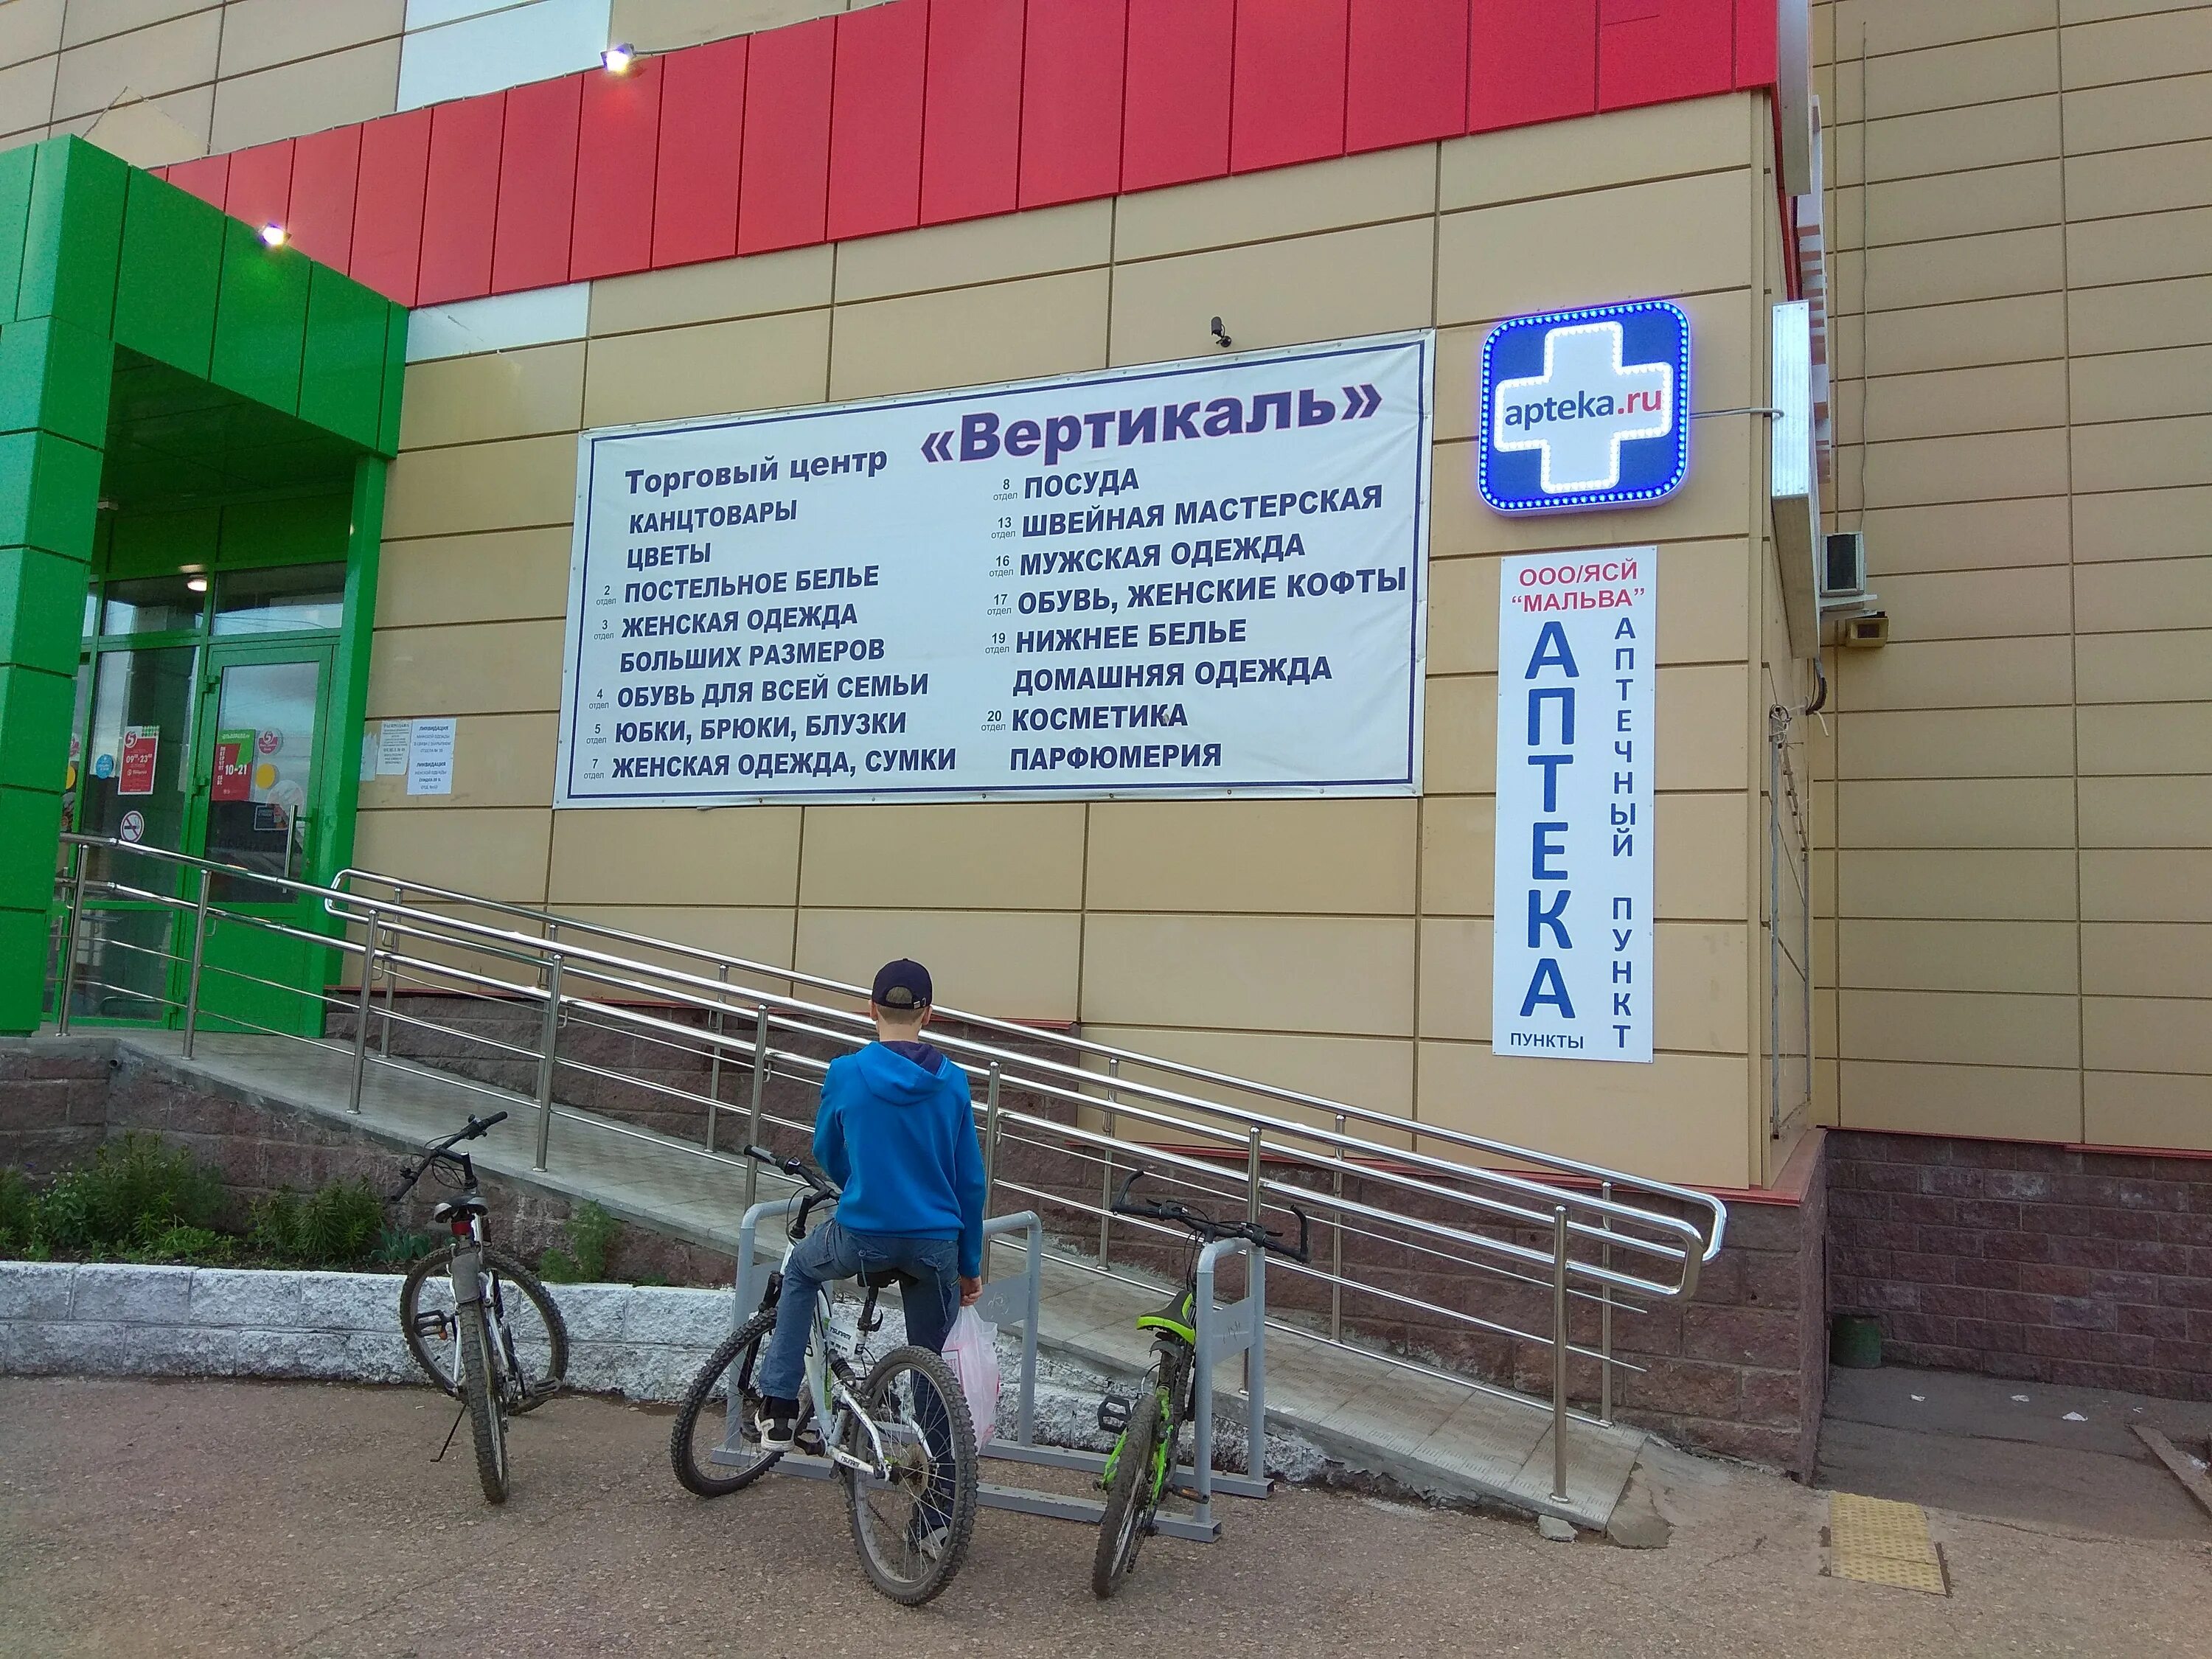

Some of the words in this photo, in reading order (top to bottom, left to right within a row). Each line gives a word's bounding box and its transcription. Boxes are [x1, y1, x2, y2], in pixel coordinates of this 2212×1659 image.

[1505, 390, 1661, 431] apteka.ru
[625, 455, 778, 496] Торговый
[790, 449, 887, 482] центр
[921, 381, 1382, 466] «Вертикаль»
[1003, 479, 1009, 490] 8
[1025, 468, 1139, 499] ПОСУДА
[993, 492, 1018, 501] отдел
[630, 500, 797, 534] КАНЦТОВАРЫ
[1023, 504, 1164, 538] ШВЕЙНАЯ
[1175, 484, 1382, 525] МАСТЕРСКАЯ
[998, 517, 1011, 528] 13
[991, 530, 1015, 540] отдел
[627, 543, 711, 571] ЦВЕТЫ
[996, 555, 1009, 567] 16
[1020, 544, 1161, 576] МУЖСКАЯ
[1171, 533, 1305, 568] ОДЕЖДА
[989, 568, 1013, 577] отдел
[604, 585, 610, 595] 2
[625, 572, 787, 603] ПОСТЕЛЬНОЕ
[796, 565, 879, 591] БЕЛЬЕ
[1018, 588, 1118, 614] ОБУВЬ,
[1127, 576, 1276, 608] ЖЕНСКИЕ
[1287, 566, 1405, 598] КОФТЫ
[596, 597, 616, 606] отдел
[994, 594, 1008, 605] 17
[987, 607, 1012, 616] отдел
[602, 619, 608, 630] 3
[622, 611, 739, 638] ЖЕНСКАЯ
[747, 603, 858, 633] ОДЕЖДА
[594, 632, 614, 640] отдел
[992, 633, 1005, 644] 19
[1016, 625, 1138, 653] НИЖНЕЕ
[1149, 619, 1246, 647] БЕЛЬЕ
[620, 647, 742, 672] БОЛЬШИХ
[749, 639, 884, 666] РАЗМЕРОВ
[985, 646, 1009, 655] отдел
[1012, 663, 1184, 697] ДОМАШНЯЯ
[1195, 656, 1332, 689] ОДЕЖДА
[597, 689, 603, 699] 4
[618, 685, 695, 707] ОБУВЬ
[701, 682, 753, 708] ДЛЯ
[762, 673, 828, 701] ВСЕЙ
[838, 673, 928, 698] СЕМЬИ
[589, 701, 609, 710] отдел
[987, 710, 1001, 722] 20
[1012, 703, 1188, 731] КОСМЕТИКА
[595, 724, 600, 734] 5
[616, 720, 692, 745] ЮБКИ,
[700, 717, 796, 742] БРЮКИ,
[806, 712, 906, 736] БЛУЗКИ
[981, 723, 1006, 732] отдел
[586, 737, 607, 745] отдел
[1610, 617, 1636, 857] АПТЕЧНЫЙ
[611, 755, 729, 778] ЖЕНСКАЯ
[738, 751, 855, 779] ОДЕЖДА,
[866, 748, 956, 772] СУМКИ
[1010, 743, 1221, 771] ПАРФЮМЕРИЯ
[225, 764, 247, 775] 10-21
[593, 759, 598, 769] 7
[584, 771, 604, 780] отдел
[1520, 621, 1579, 1019] АПТЕКА
[1613, 897, 1632, 1048] ПУНКТ
[1511, 1033, 1583, 1048] ПУНКТЫ
[830, 1326, 852, 1340] TSUNAMI
